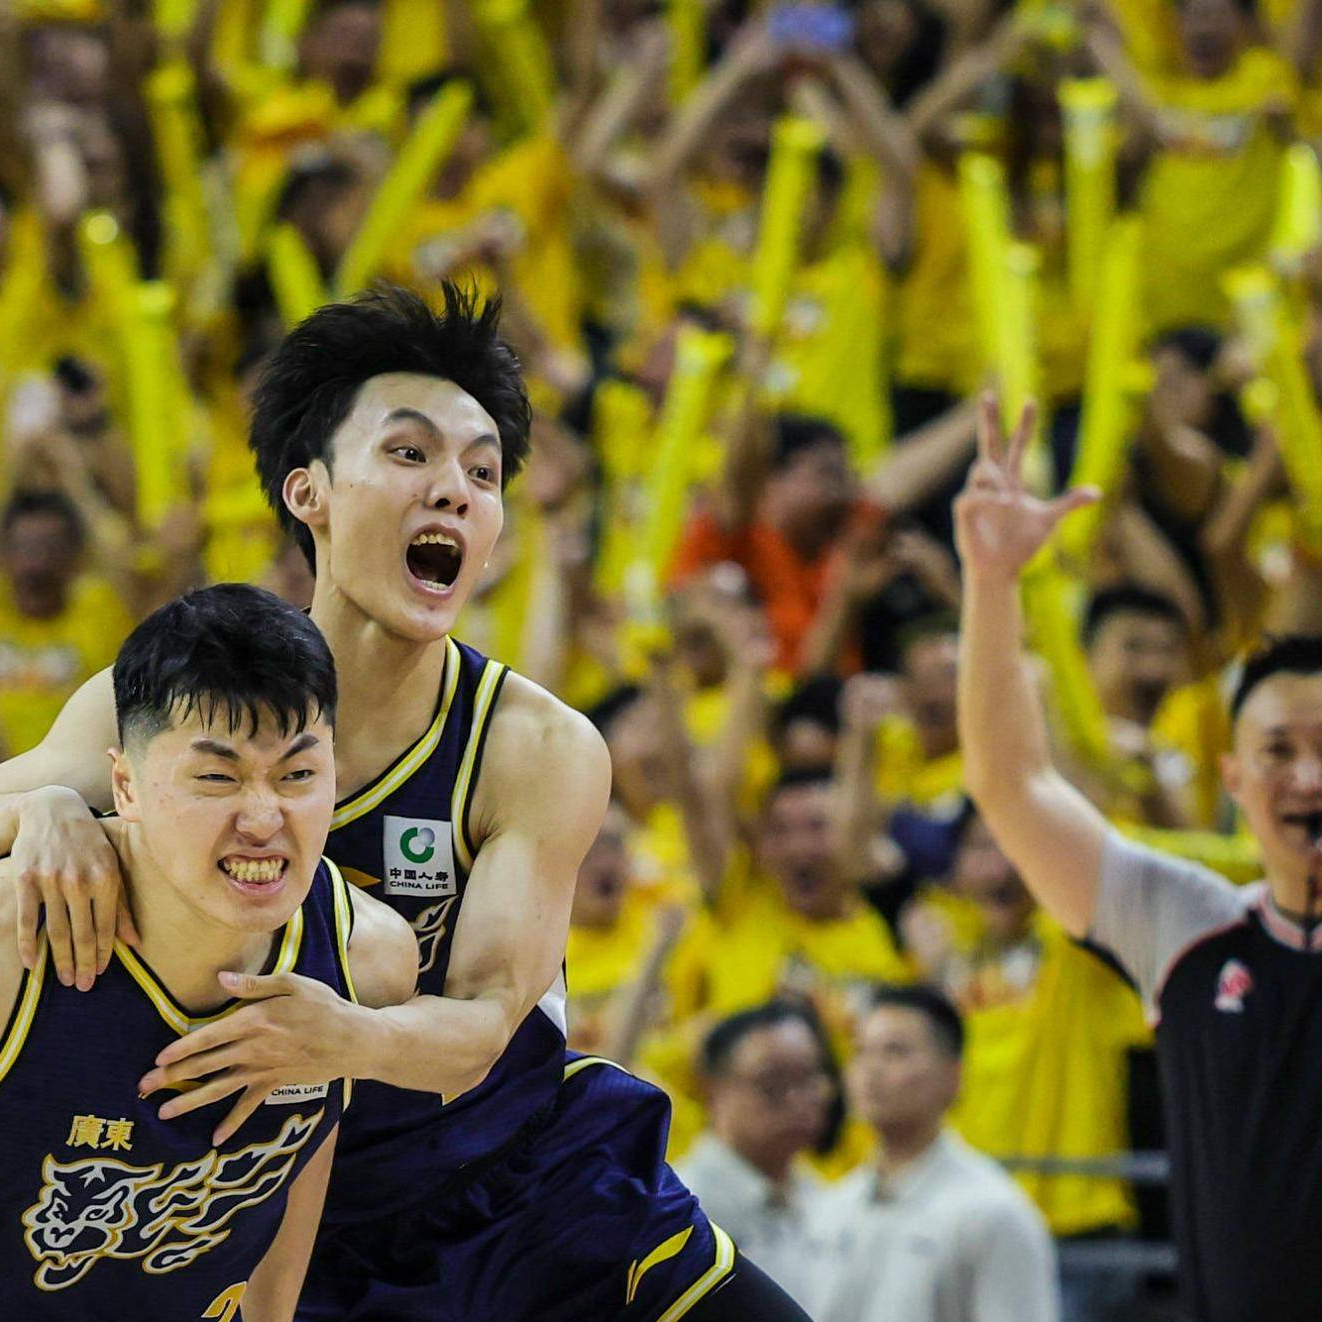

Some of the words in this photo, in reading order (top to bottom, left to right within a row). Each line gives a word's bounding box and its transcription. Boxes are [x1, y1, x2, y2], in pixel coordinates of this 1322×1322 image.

[390, 880, 422, 889] CHINA
[271, 1088, 301, 1096] CHINA
[304, 1085, 324, 1094] LIFE
[65, 1114, 135, 1151] 廣東
